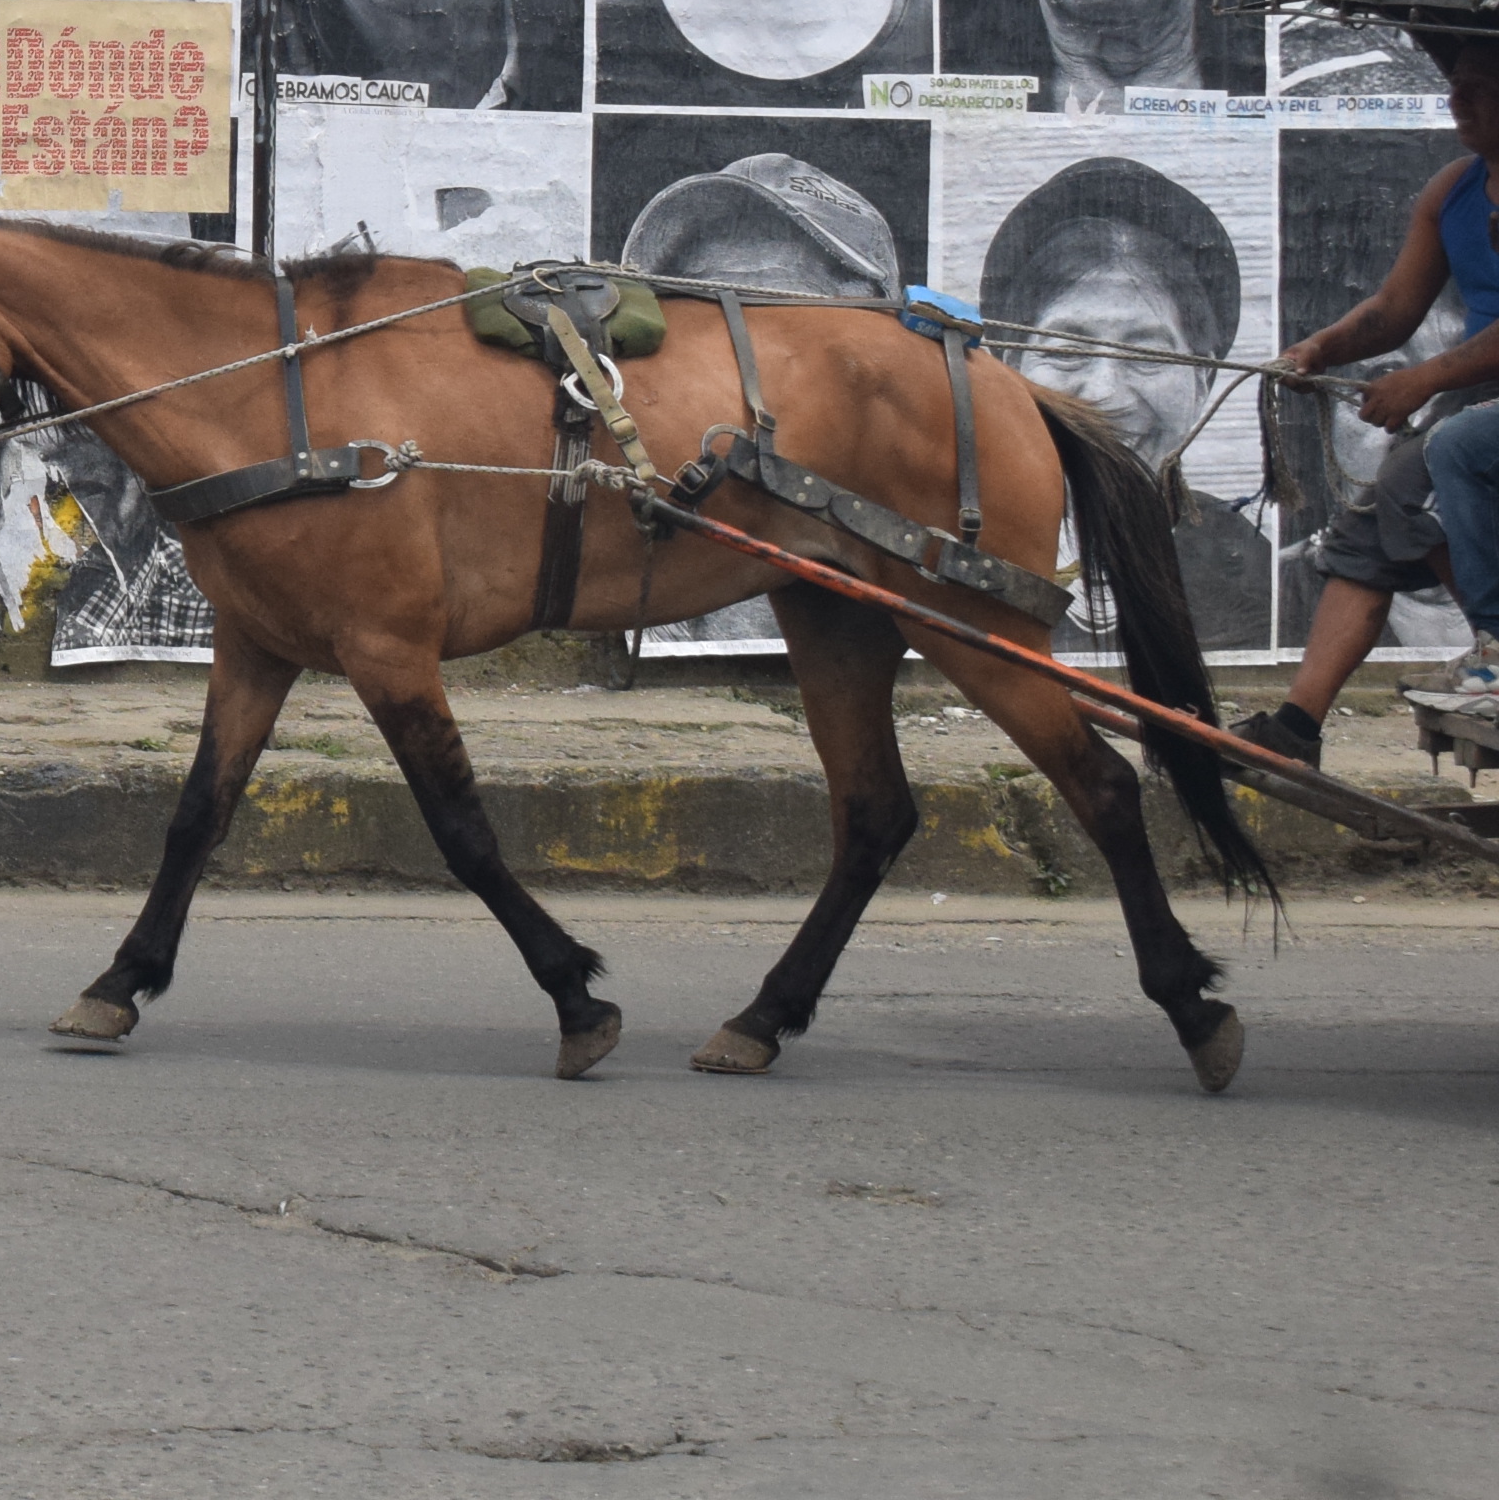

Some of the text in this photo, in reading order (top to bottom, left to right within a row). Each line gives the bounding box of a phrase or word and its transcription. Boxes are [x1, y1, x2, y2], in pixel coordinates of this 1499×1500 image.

[365, 81, 425, 103] CAUCA
[930, 77, 1034, 90] SOMOS PARTE DE LOS
[870, 80, 913, 108] NO
[918, 94, 1023, 110] DESAPARECIDOS
[1200, 101, 1216, 114] EN
[1226, 99, 1273, 112] CAUCA
[1278, 100, 1287, 111] Y
[1289, 100, 1306, 112] EN
[1308, 100, 1322, 112] EL
[1337, 97, 1384, 111] PODER
[1387, 98, 1403, 110] DE
[1407, 97, 1423, 110] SU
[1, 101, 209, 176] Están?
